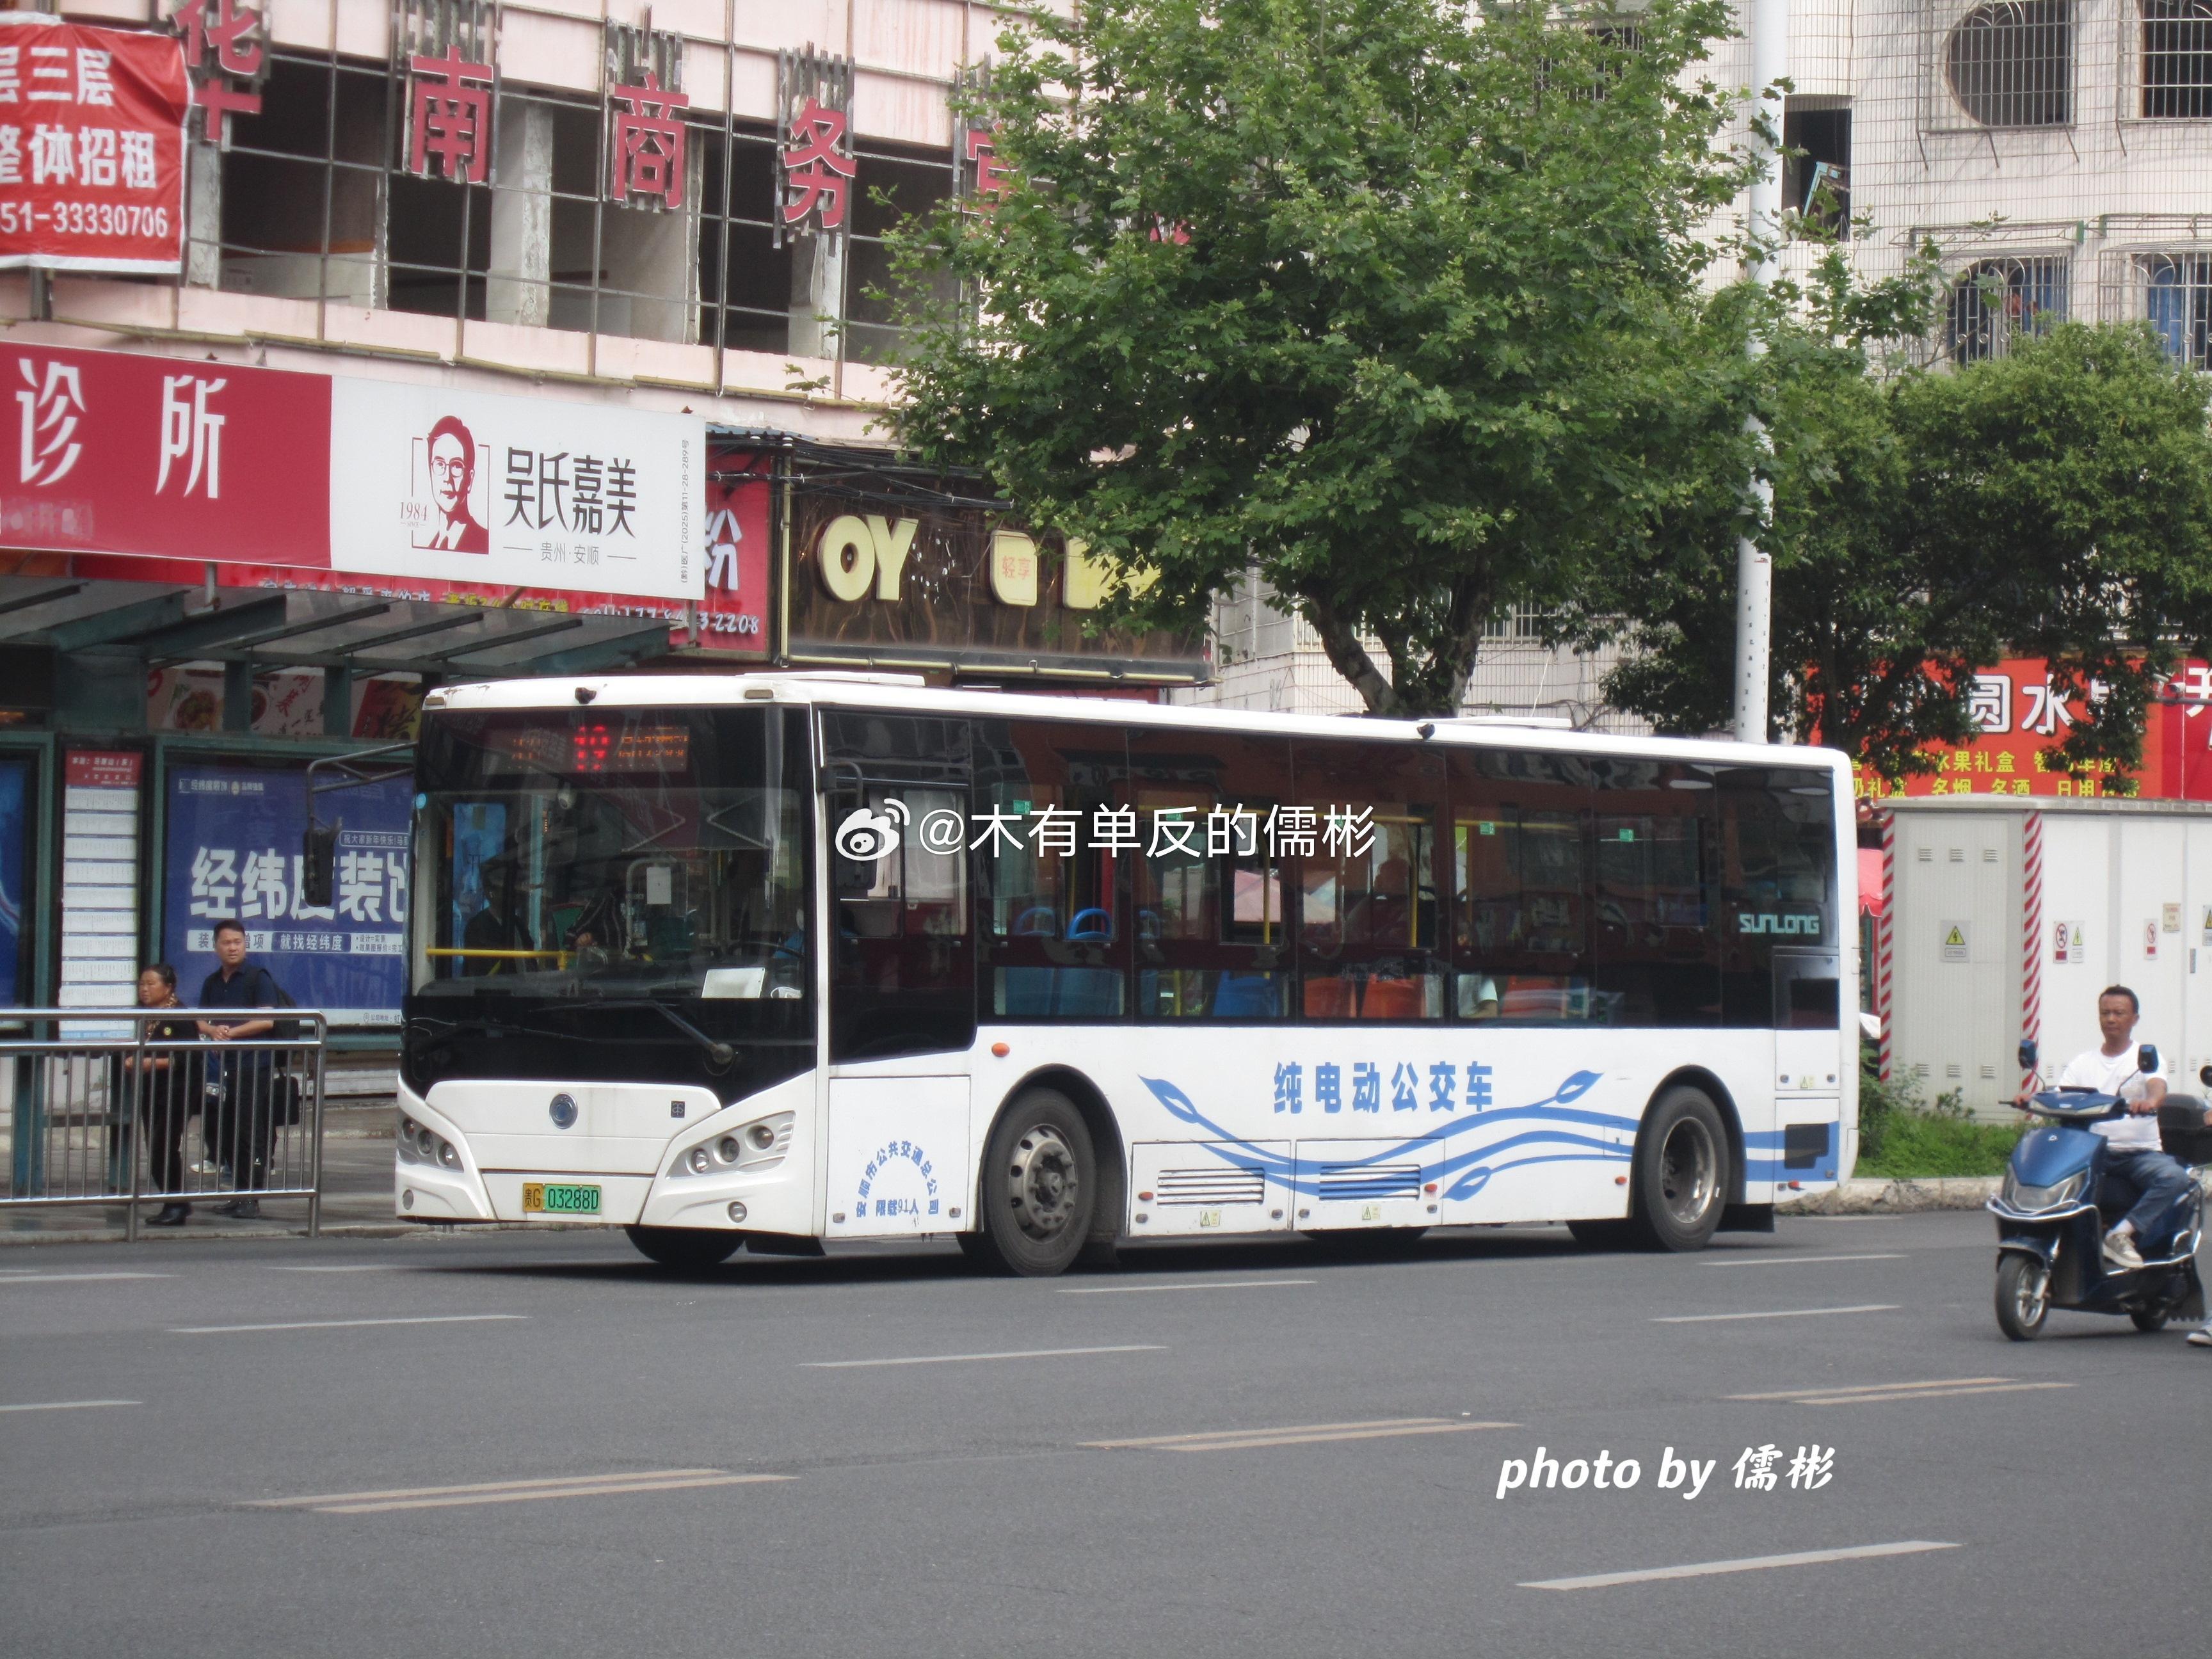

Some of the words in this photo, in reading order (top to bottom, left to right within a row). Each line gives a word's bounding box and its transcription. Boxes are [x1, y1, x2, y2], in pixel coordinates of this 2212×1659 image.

[0, 201, 168, 238] 51-33330706
[16, 357, 228, 499] 诊所
[503, 446, 637, 539] 吴氏嘉美
[400, 501, 428, 521] 1984
[540, 541, 600, 565] 贵州·安顺
[714, 613, 760, 634] 2208
[189, 846, 407, 923] 经纬装
[1738, 913, 1820, 934] SUNLONG
[280, 933, 343, 952] 就找经纬度
[1273, 1061, 1493, 1114] 纯电动公交车
